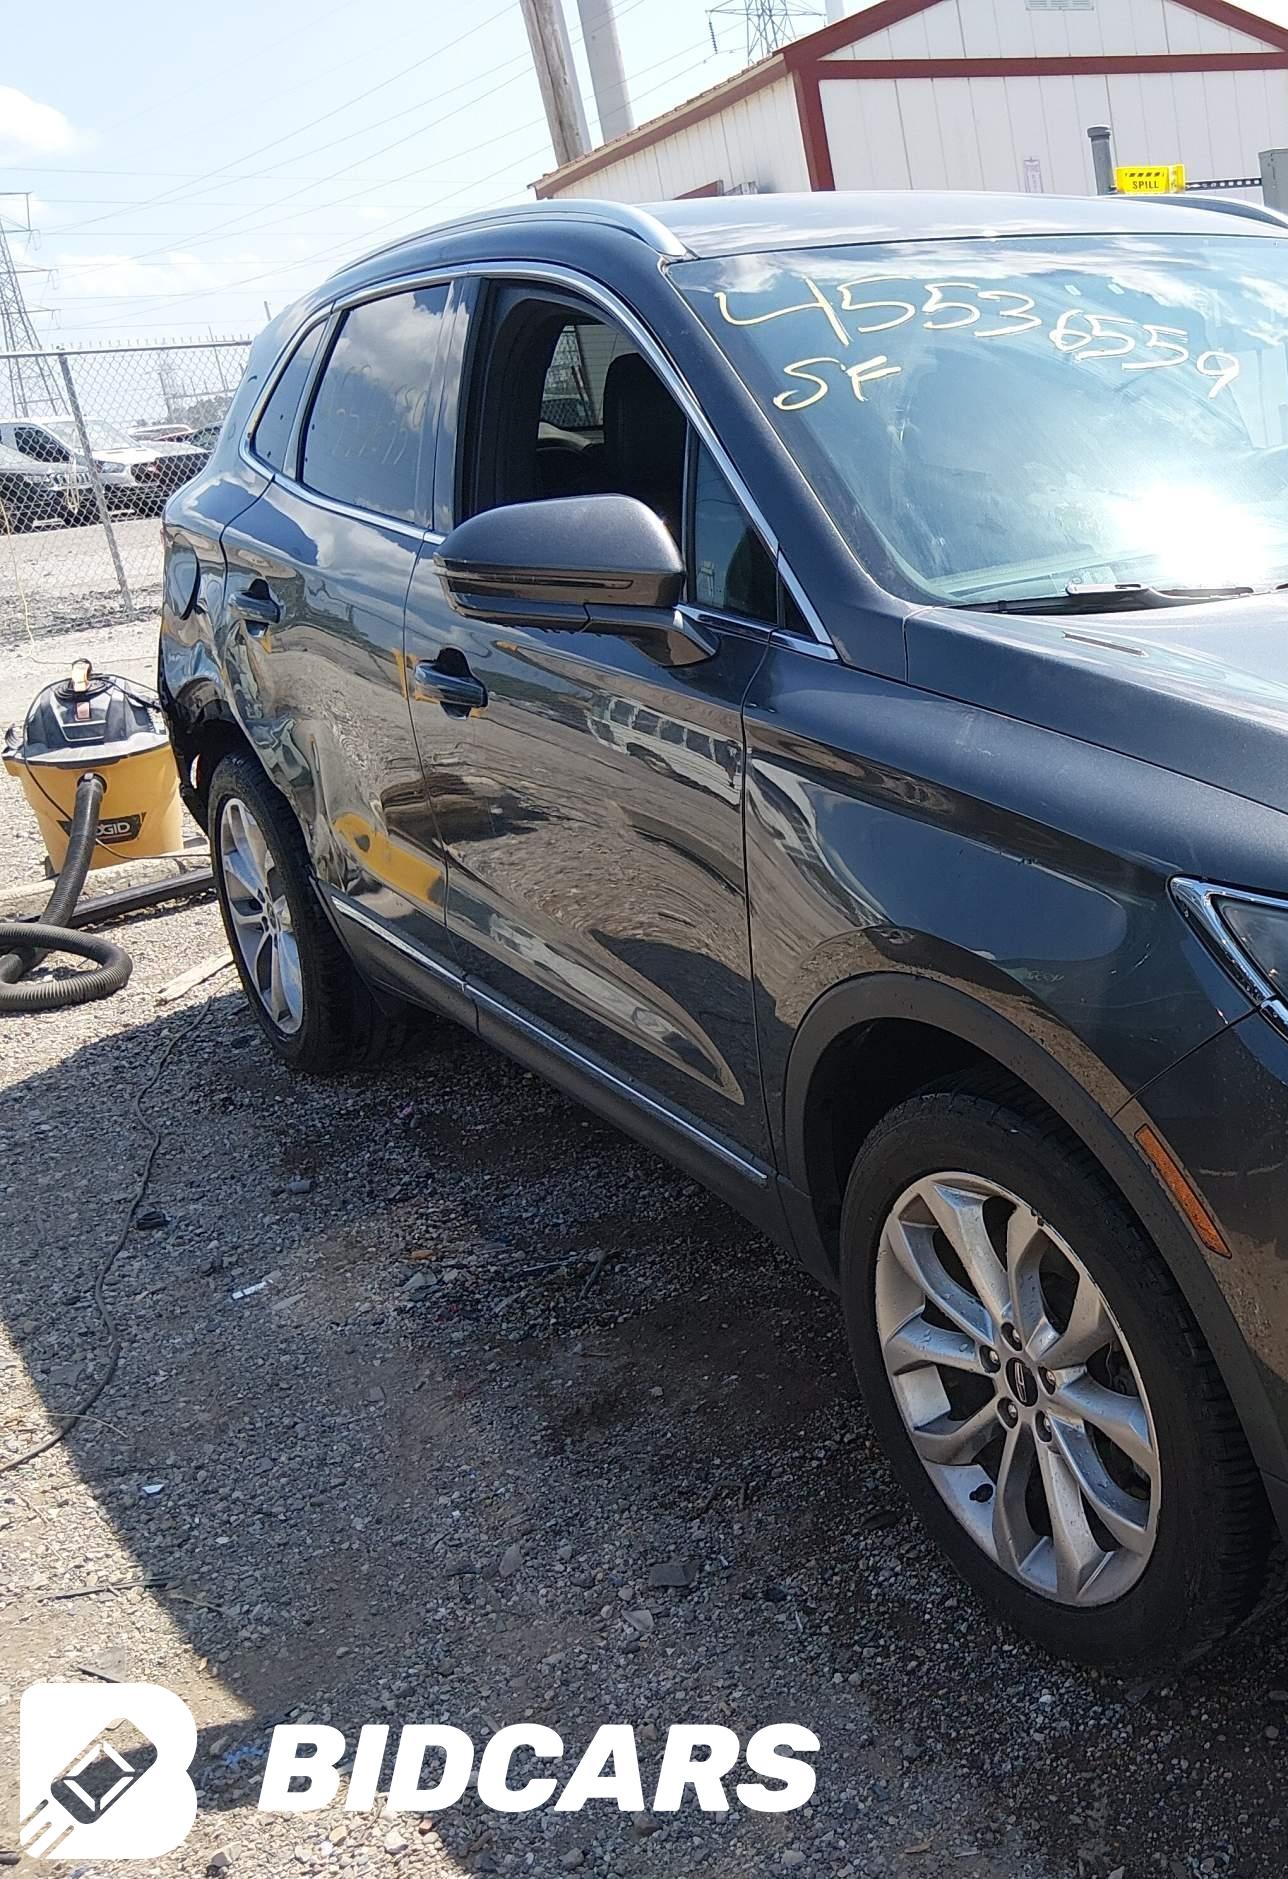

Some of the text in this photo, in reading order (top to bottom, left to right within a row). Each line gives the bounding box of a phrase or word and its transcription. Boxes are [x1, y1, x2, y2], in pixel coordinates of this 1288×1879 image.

[1132, 181, 1159, 189] SPILL
[714, 275, 1241, 399] 45536559
[772, 355, 901, 411] SF
